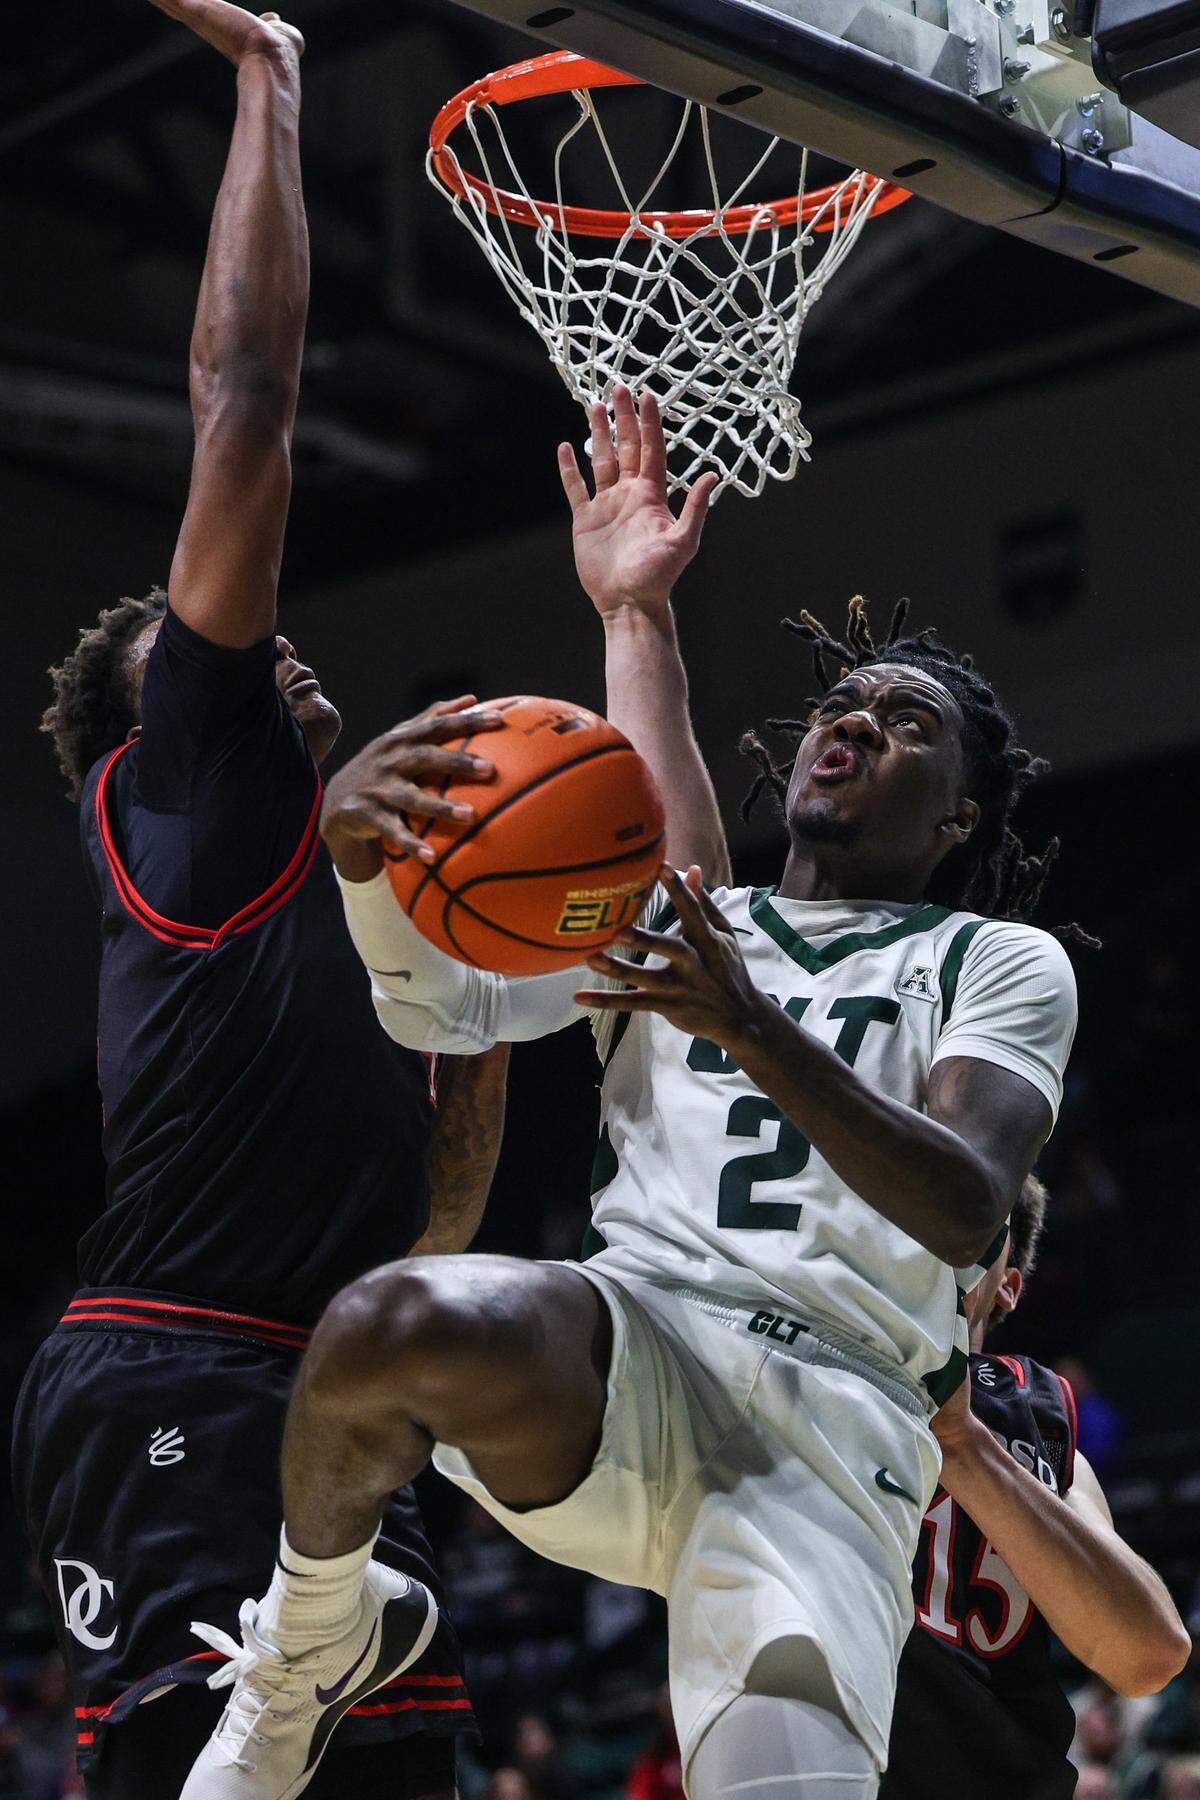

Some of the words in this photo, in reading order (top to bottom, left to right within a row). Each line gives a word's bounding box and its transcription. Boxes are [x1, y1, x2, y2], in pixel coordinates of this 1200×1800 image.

[717, 1095, 811, 1231] 2
[53, 1559, 118, 1650] DC
[915, 1492, 1035, 1658] 15
